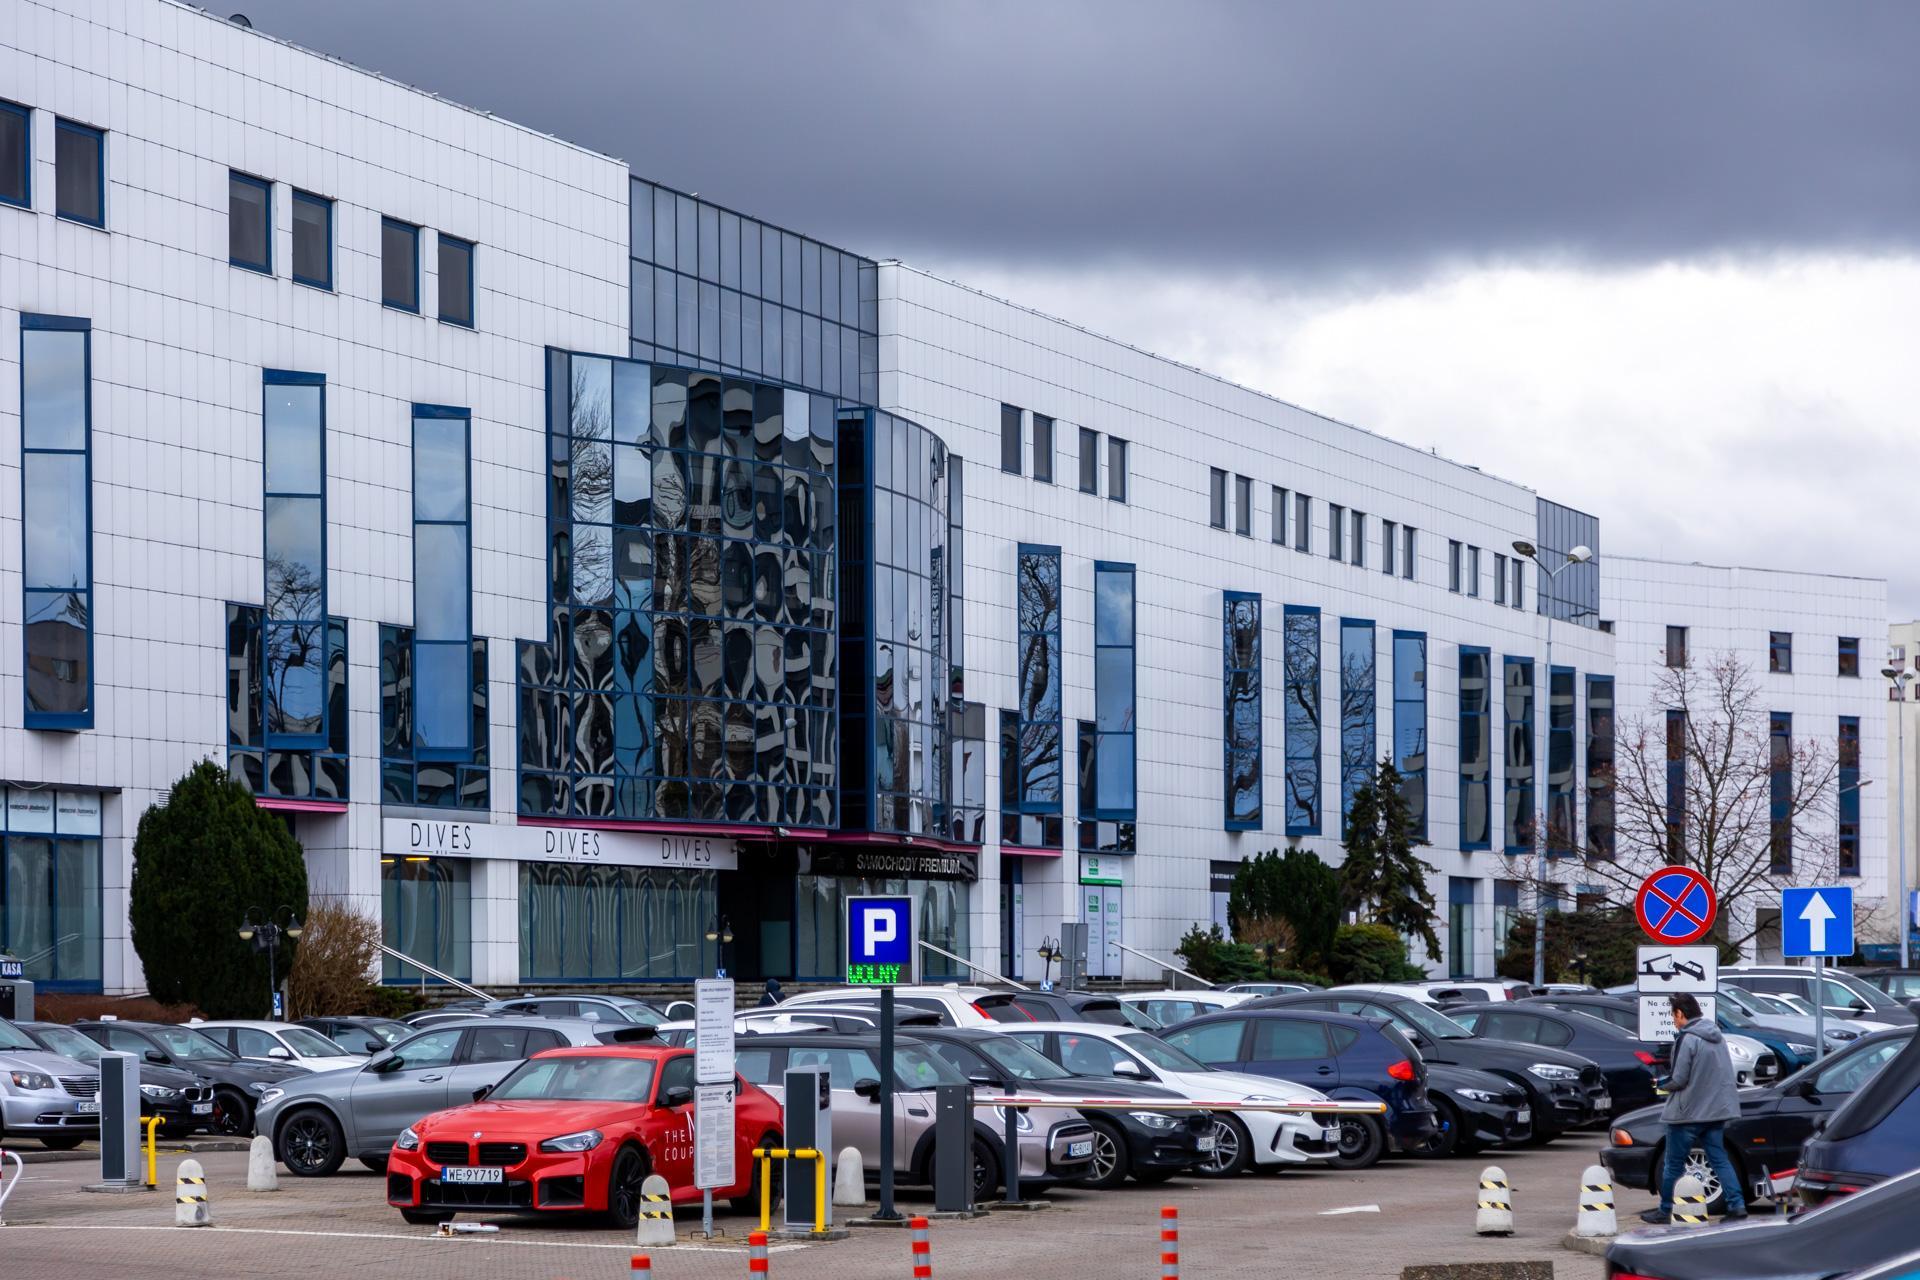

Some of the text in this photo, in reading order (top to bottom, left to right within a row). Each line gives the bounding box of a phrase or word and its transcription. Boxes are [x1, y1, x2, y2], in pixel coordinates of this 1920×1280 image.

[411, 822, 472, 850] DIVES
[545, 830, 600, 856] DIVES
[661, 838, 711, 862] DIVES
[857, 853, 960, 874] SAMOCHODY PREMIUM
[864, 908, 897, 956] P
[2, 962, 22, 976] KASA
[664, 1129, 686, 1144] THE
[664, 1145, 694, 1161] COUP
[448, 1168, 500, 1181] WE 9Y719
